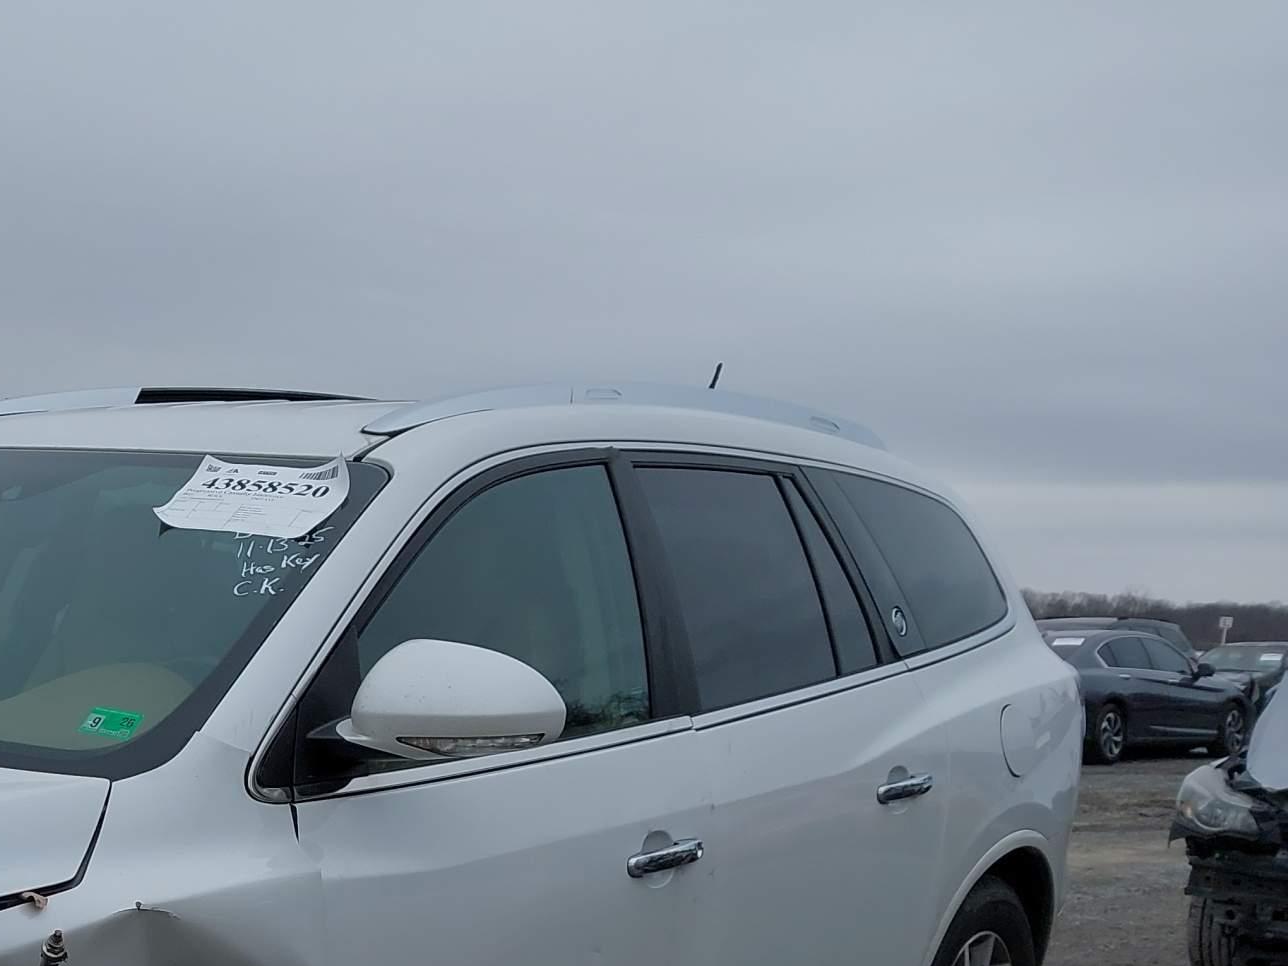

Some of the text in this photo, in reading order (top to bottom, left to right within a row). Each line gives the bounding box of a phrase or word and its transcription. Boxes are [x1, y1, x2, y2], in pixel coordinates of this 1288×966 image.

[202, 477, 330, 498] 43858520
[241, 552, 321, 577] Has Key
[89, 716, 102, 728] 9
